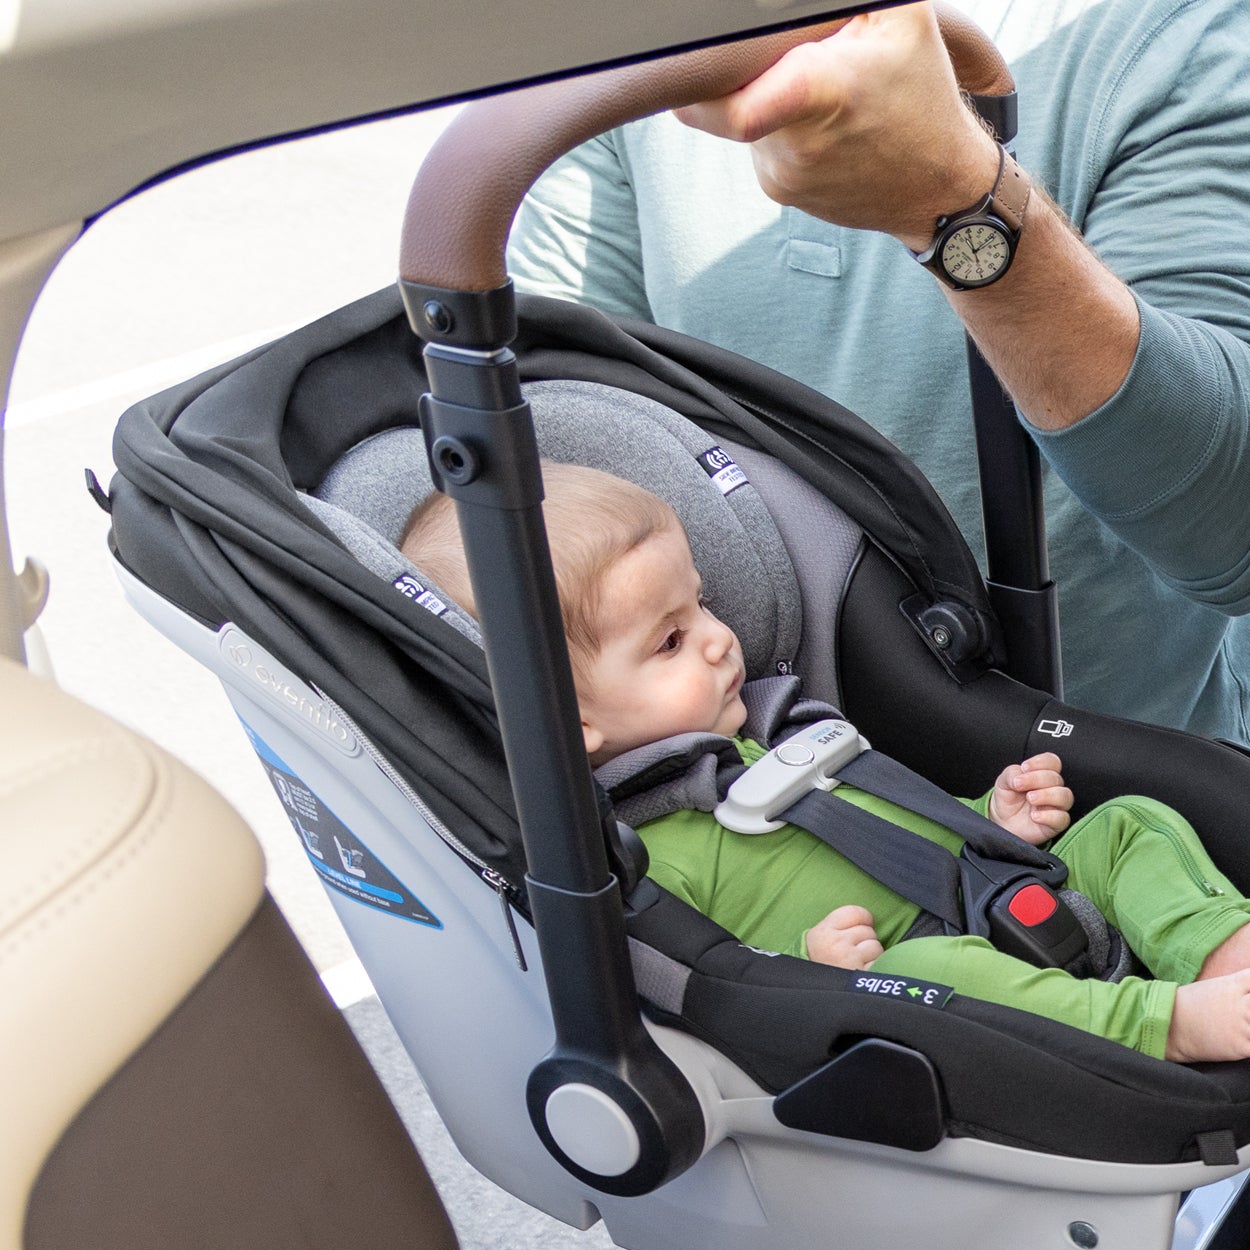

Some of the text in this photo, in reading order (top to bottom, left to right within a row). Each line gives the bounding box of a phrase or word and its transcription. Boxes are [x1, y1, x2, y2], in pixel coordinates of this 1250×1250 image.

[255, 664, 347, 740] evenflo
[818, 730, 843, 744] SAFE
[856, 978, 939, 1004] 3 35lbs
